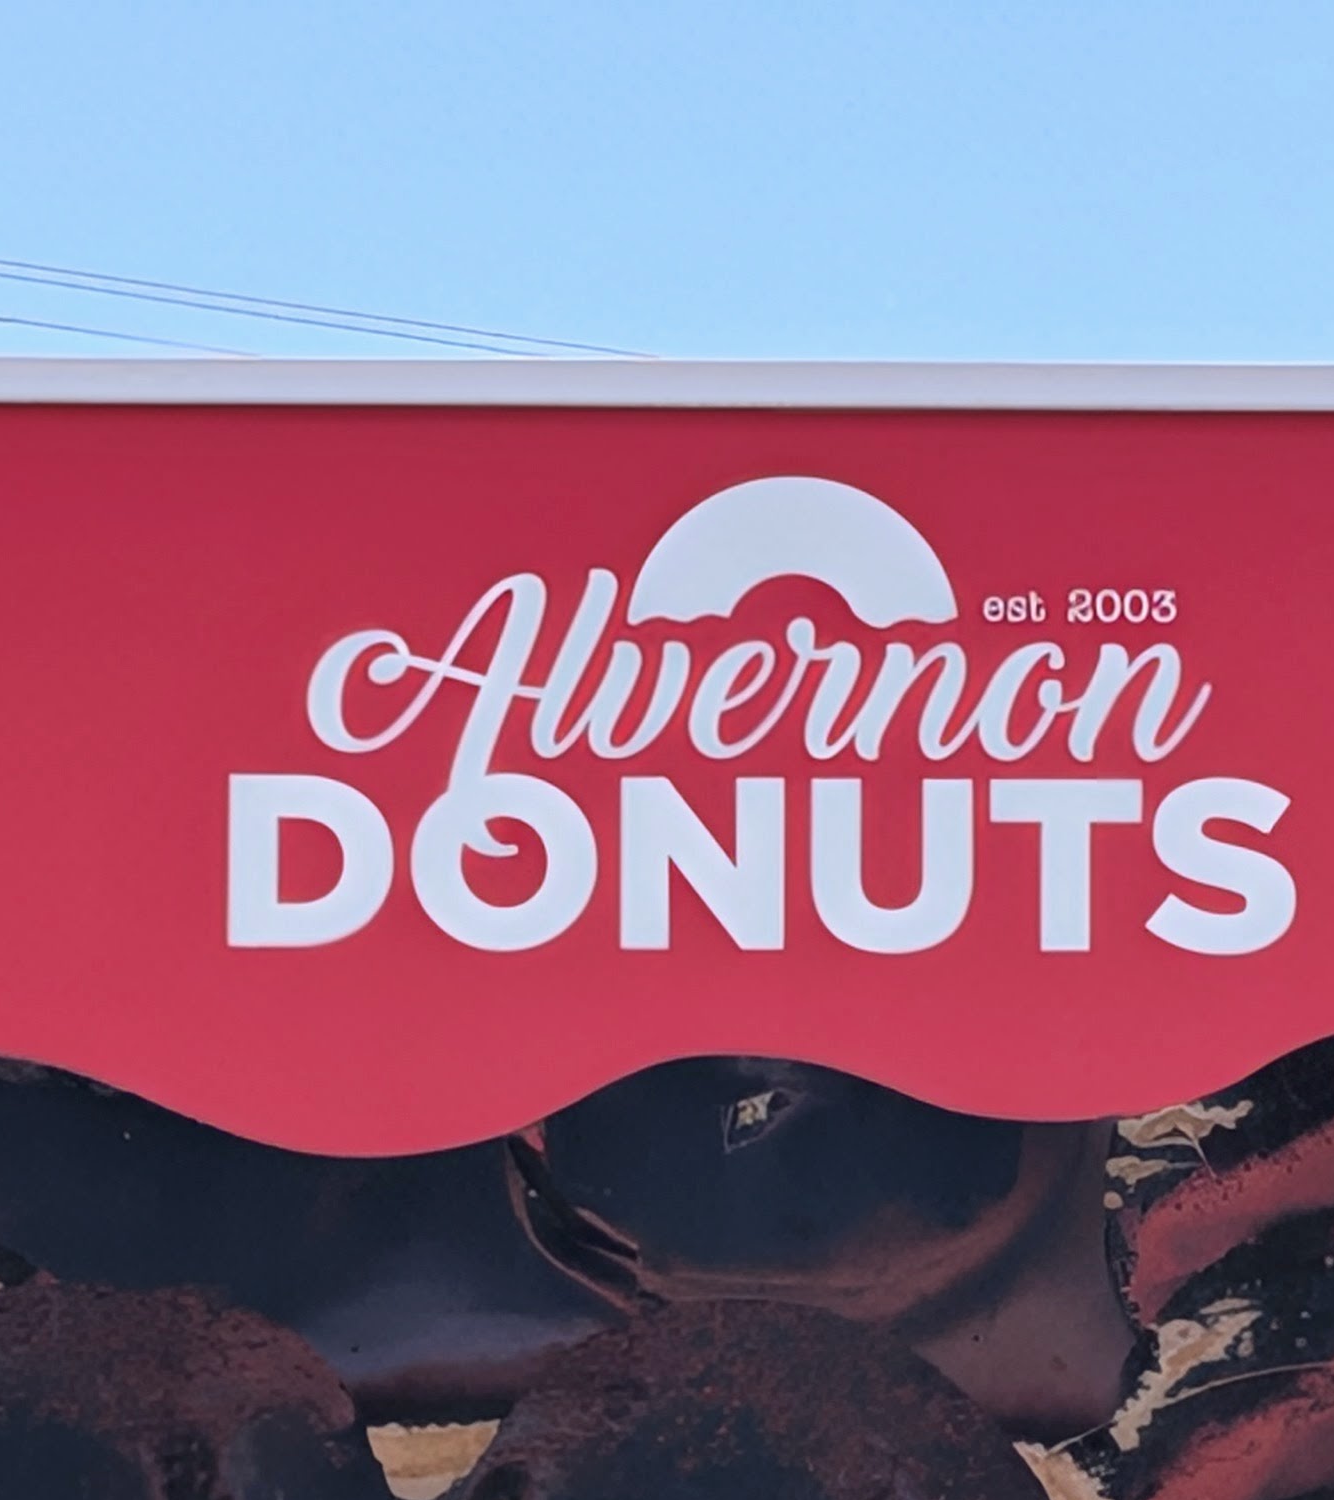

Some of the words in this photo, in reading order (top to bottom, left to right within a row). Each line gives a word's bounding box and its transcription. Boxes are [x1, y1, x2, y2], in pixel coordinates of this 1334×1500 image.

[983, 591, 1046, 622] est
[1067, 589, 1177, 623] 2003
[307, 569, 1211, 855] Alvernon
[226, 774, 1297, 955] DONUTS
